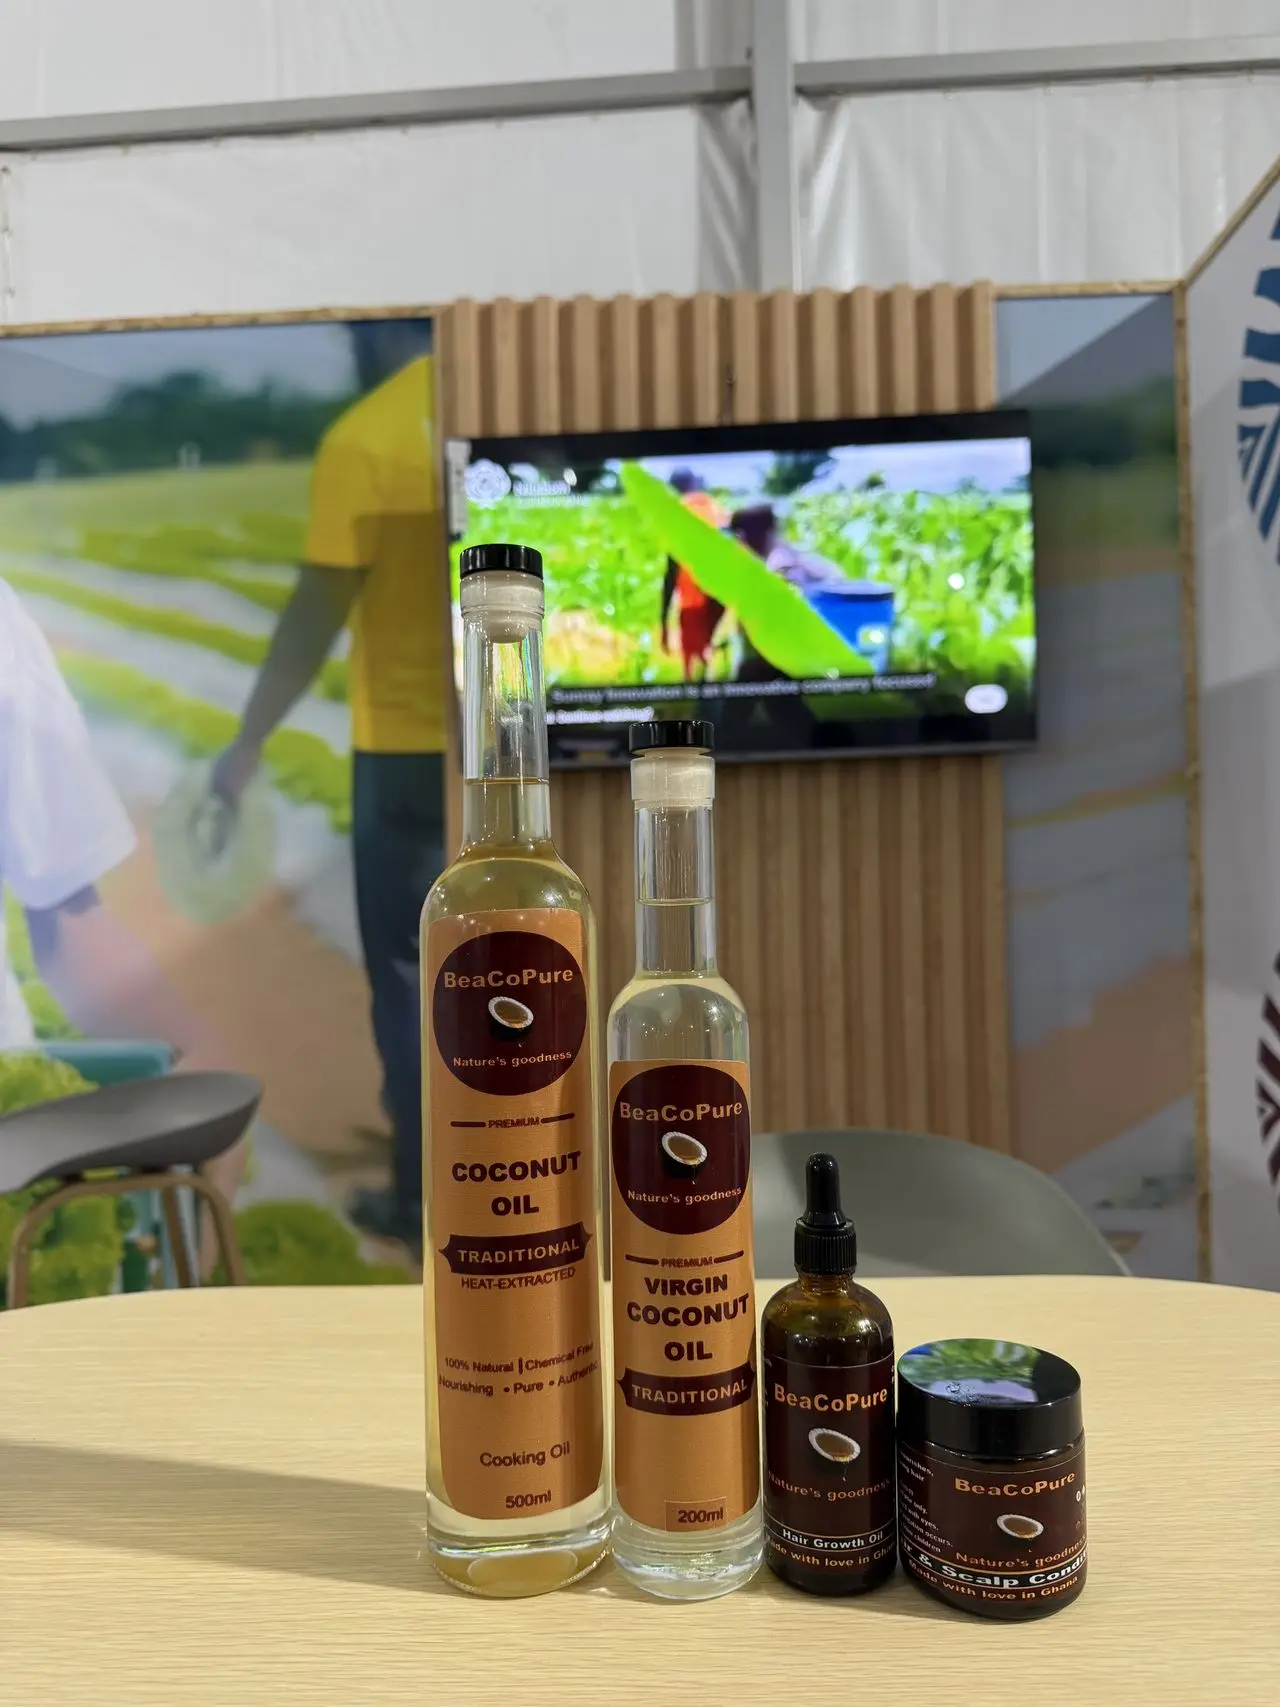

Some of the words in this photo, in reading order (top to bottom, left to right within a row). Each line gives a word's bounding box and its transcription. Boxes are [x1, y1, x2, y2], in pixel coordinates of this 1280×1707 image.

[444, 968, 573, 988] BeaCoPure
[453, 1055, 507, 1067] Nature's
[512, 1051, 572, 1067] goodness
[620, 1101, 743, 1121] BeaCoPure
[488, 1117, 540, 1128] PREMIUM
[452, 1151, 582, 1182] COCONUT
[491, 1195, 540, 1216] OIL
[627, 1189, 680, 1204] Nature's
[685, 1187, 742, 1205] goodness
[458, 1239, 580, 1264] TRADITIONAL
[661, 1256, 714, 1268] PREMIUM
[461, 1266, 576, 1290] HEAT-EXTRACTED
[644, 1274, 728, 1296] VIRGIN
[626, 1293, 749, 1327] COCONUT
[663, 1340, 713, 1361] OIL
[444, 1357, 469, 1371] 100%
[472, 1361, 514, 1373] Natural
[525, 1350, 575, 1371] Chemical
[439, 1374, 494, 1396] Nourishing
[513, 1381, 544, 1394] Pure
[631, 1378, 748, 1404] TRADITIONAL
[774, 1383, 888, 1412] BeaCoPure
[479, 1451, 546, 1467] Cooking
[550, 1441, 571, 1459] Oil
[954, 1472, 1076, 1497] BeaCoPure
[505, 1490, 552, 1509] 500ml
[678, 1507, 724, 1523] 200ml
[782, 1529, 809, 1545] Hair
[813, 1538, 865, 1549] Growth
[869, 1530, 883, 1544] Oil
[914, 1534, 942, 1553] children
[925, 1530, 954, 1548] occurs.
[791, 1552, 820, 1566] with
[825, 1558, 854, 1568] love
[858, 1555, 870, 1565] in
[955, 1551, 1029, 1568] Nature's
[908, 1559, 938, 1583] Made
[943, 1581, 976, 1596] with
[982, 1590, 1017, 1600] love
[1022, 1590, 1036, 1600] in
[1041, 1575, 1078, 1597] Ghana
[918, 1553, 933, 1567] &
[942, 1565, 1019, 1589] Scalp
